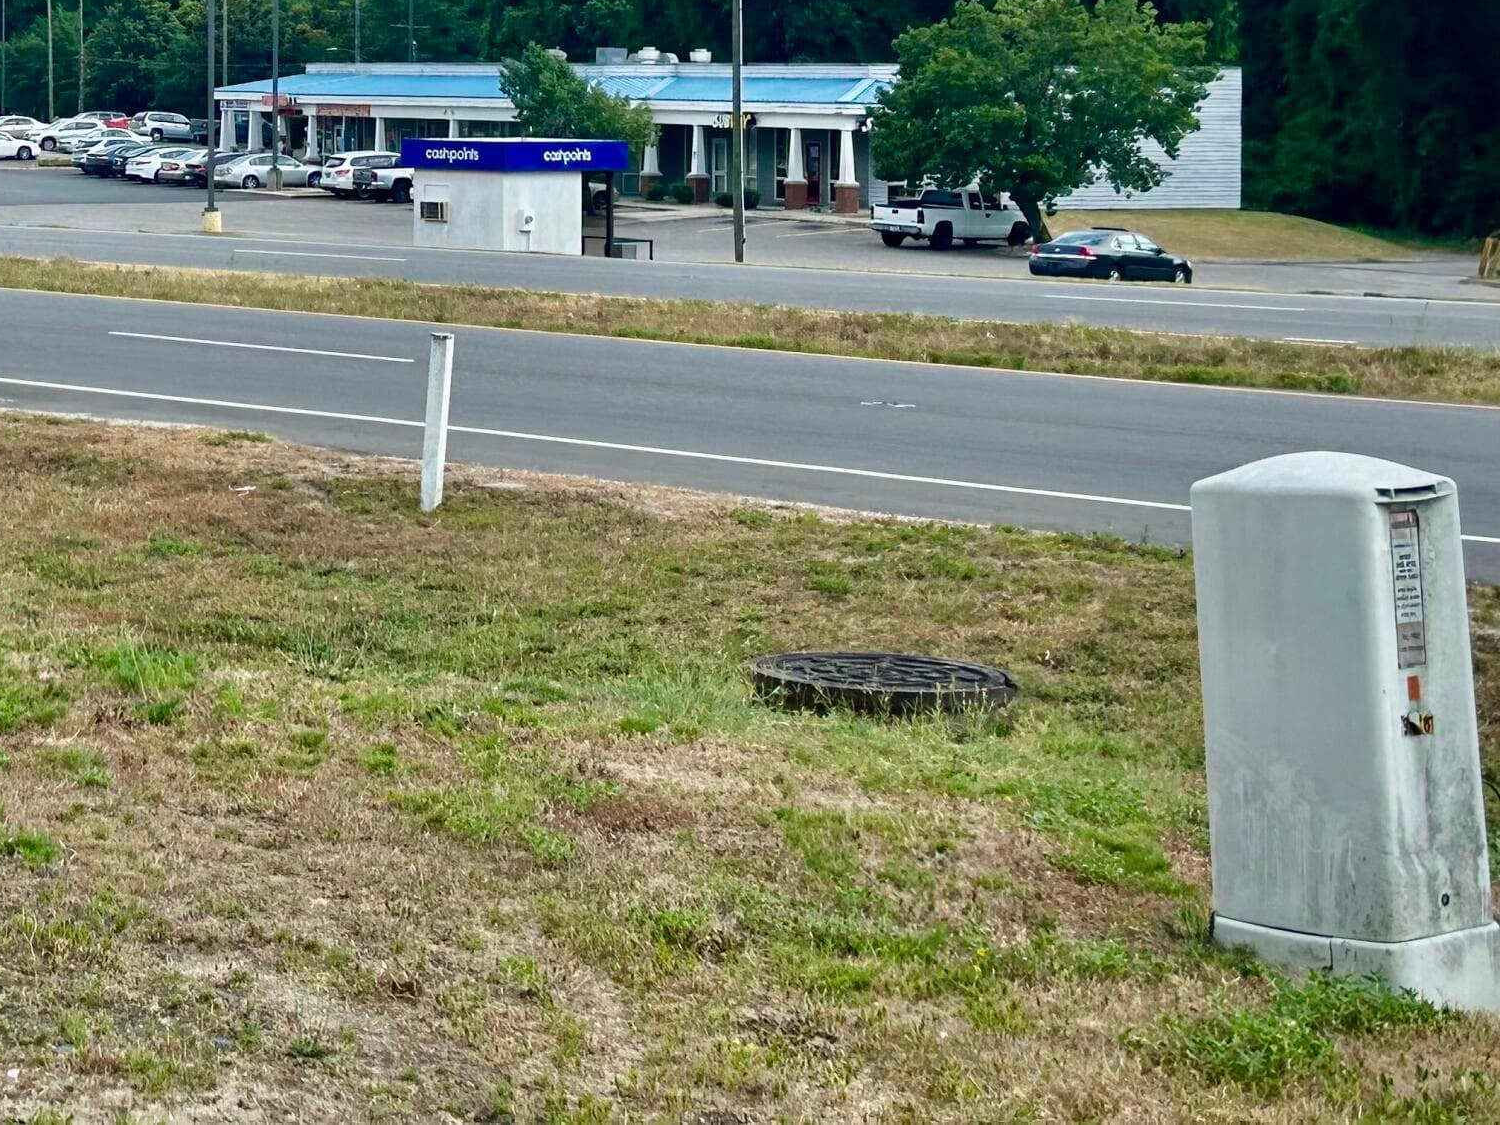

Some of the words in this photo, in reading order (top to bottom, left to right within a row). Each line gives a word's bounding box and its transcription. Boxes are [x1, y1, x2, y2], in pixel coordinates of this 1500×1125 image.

[711, 114, 751, 129] SUBY
[425, 147, 480, 163] cashpoints
[543, 148, 592, 165] cashpoints
